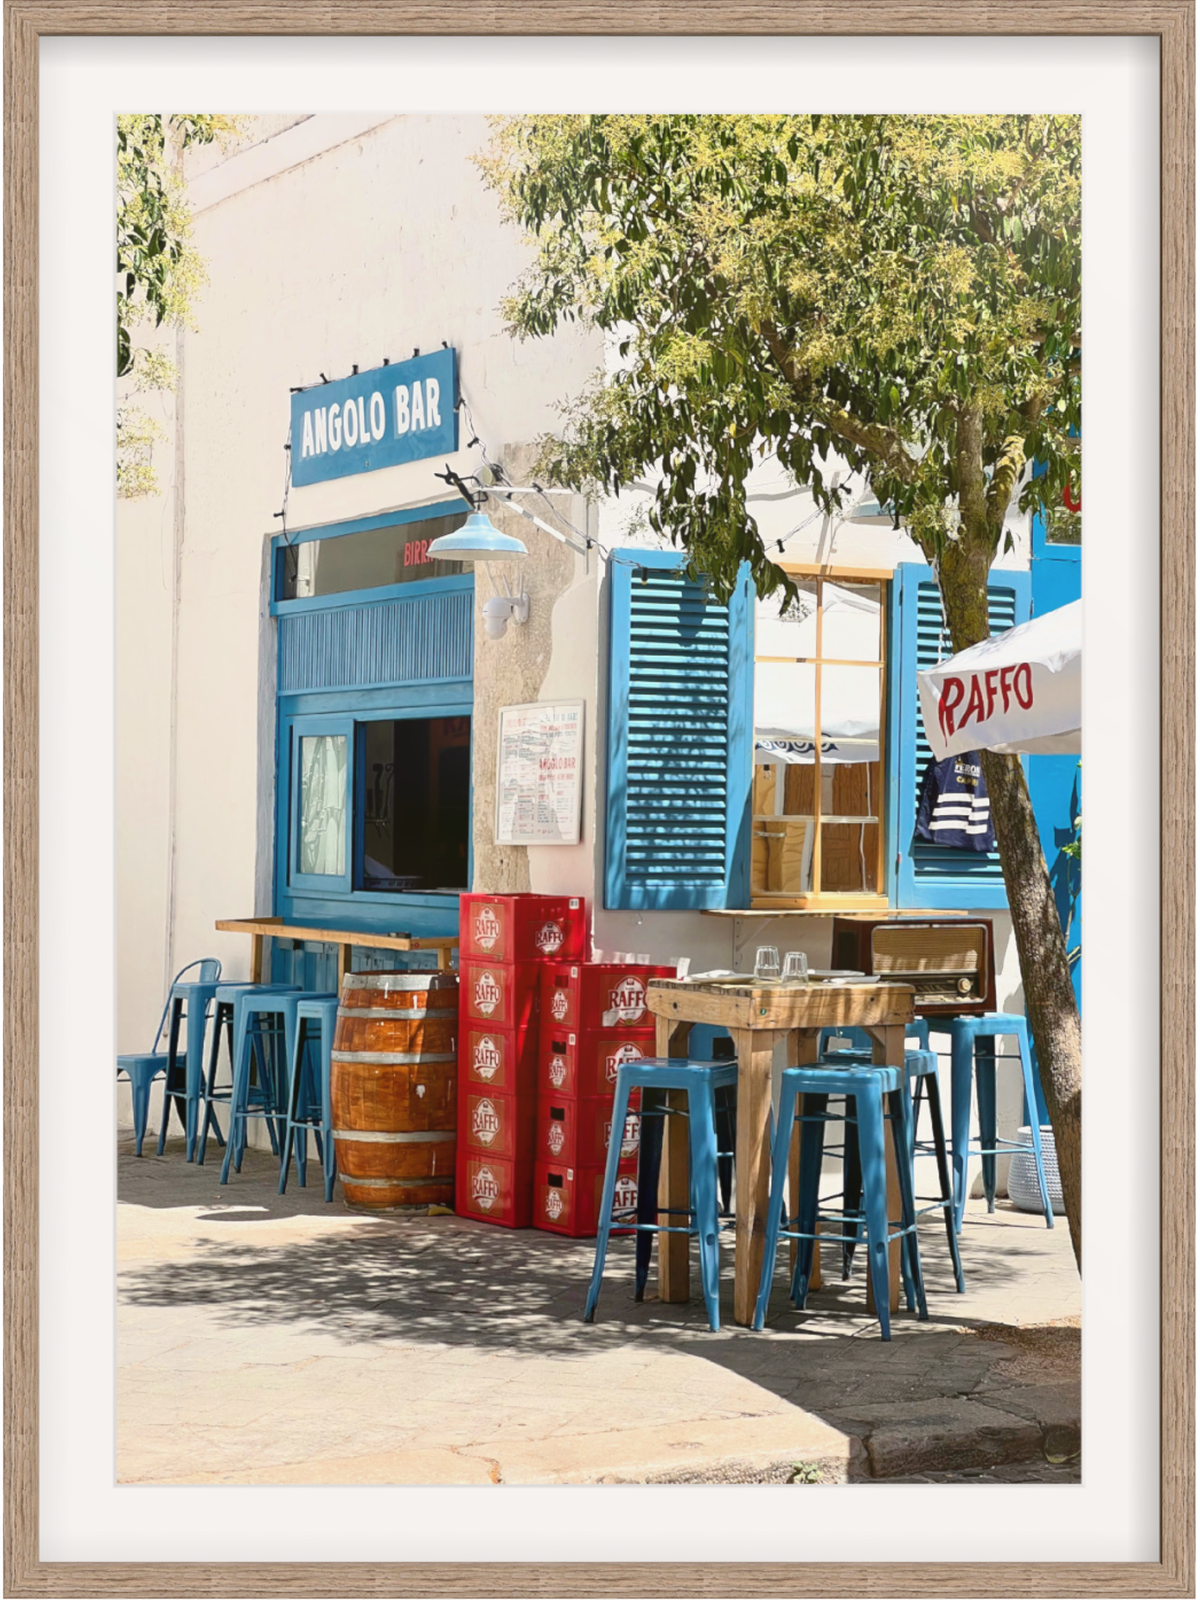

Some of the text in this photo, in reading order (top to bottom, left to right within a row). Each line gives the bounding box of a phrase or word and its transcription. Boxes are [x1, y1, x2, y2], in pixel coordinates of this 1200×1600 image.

[302, 378, 441, 458] ANGOLO BAR
[938, 662, 1034, 748] RAFFO
[475, 918, 500, 939] RAFFO
[536, 931, 564, 945] RAFFO
[474, 983, 500, 1003] RAFFO
[473, 1046, 499, 1067] RAFFO
[472, 1110, 498, 1132] RAFFO
[471, 1175, 498, 1199] RAFFO
